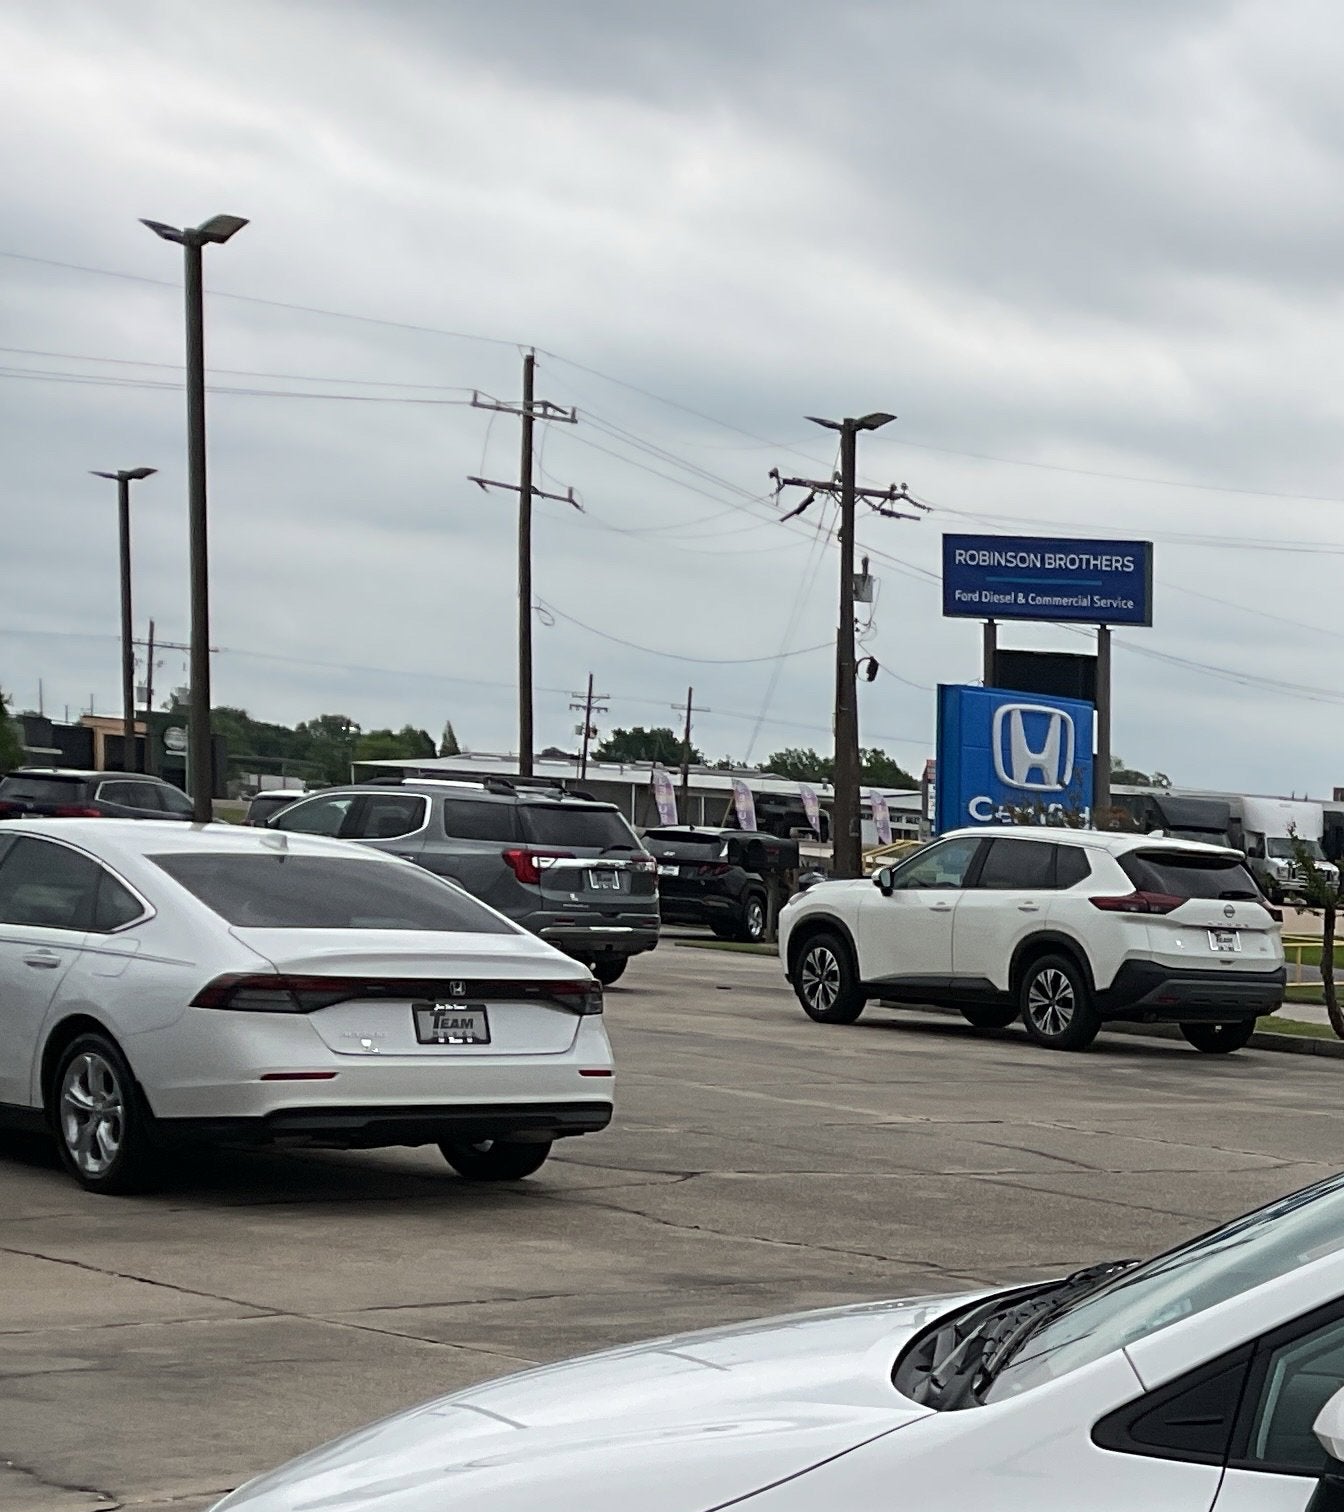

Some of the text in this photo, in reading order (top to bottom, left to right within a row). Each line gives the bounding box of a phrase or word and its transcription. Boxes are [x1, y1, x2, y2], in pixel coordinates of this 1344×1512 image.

[955, 549, 1134, 572] ROBINSON BROTHERS
[955, 590, 1135, 609] Ford Diesel & Commercial Service
[430, 1011, 474, 1029] TEAM
